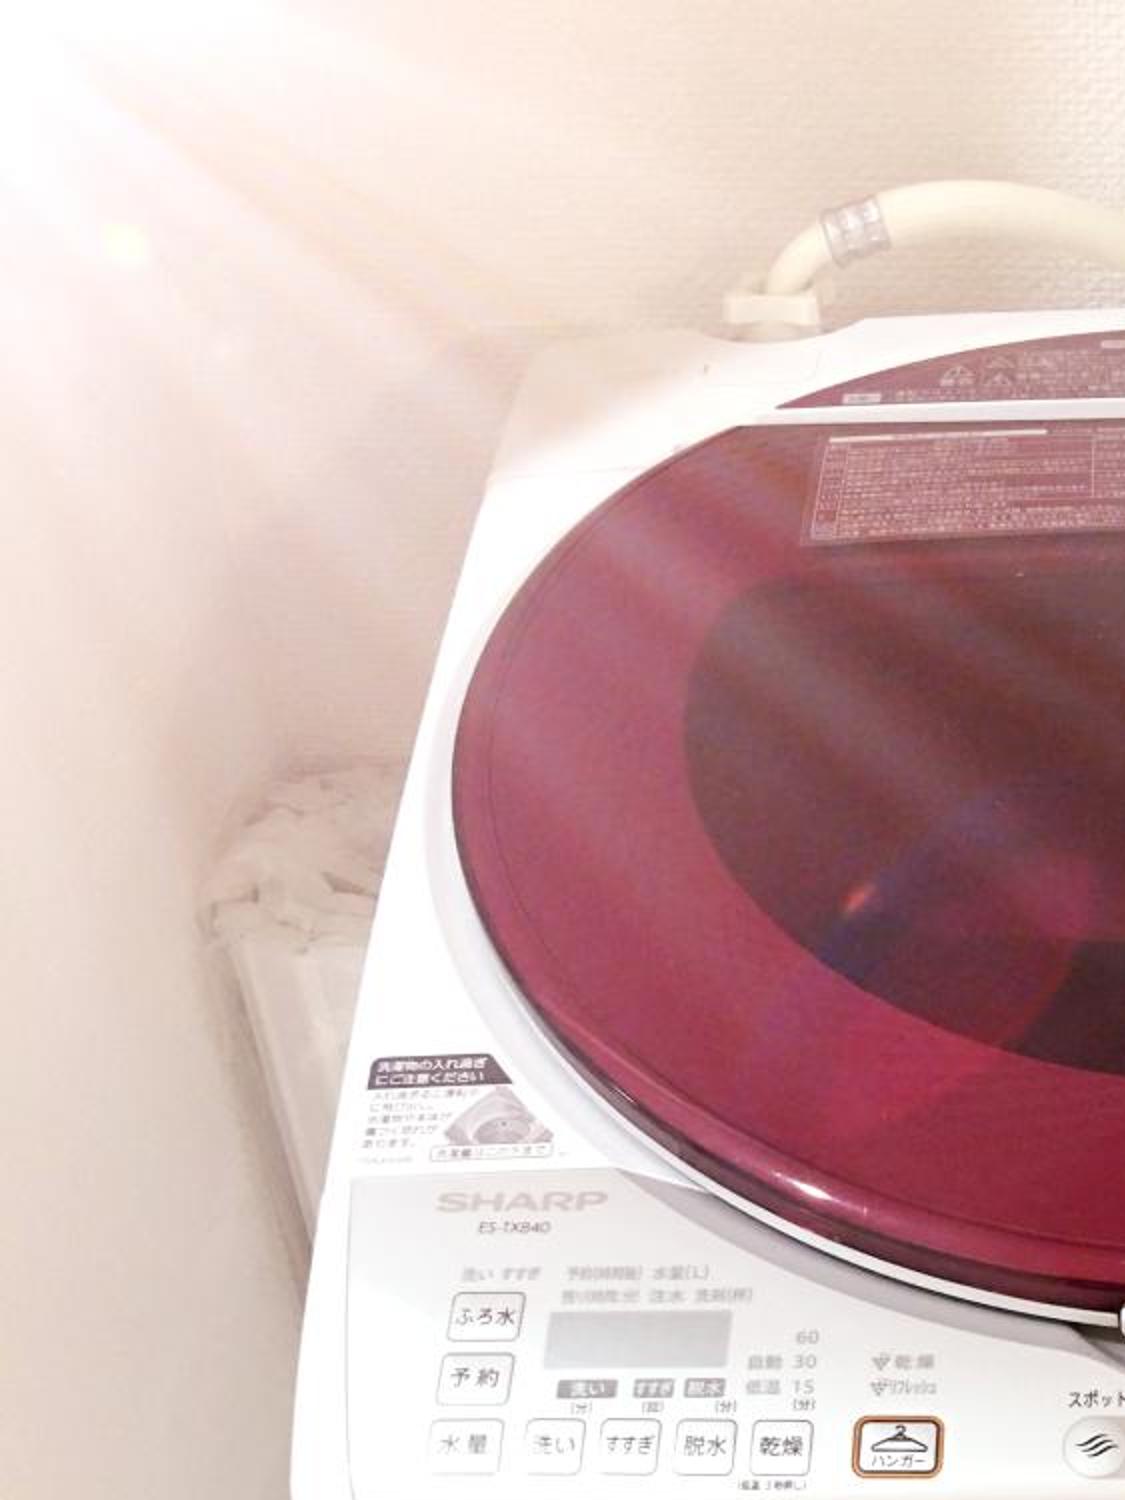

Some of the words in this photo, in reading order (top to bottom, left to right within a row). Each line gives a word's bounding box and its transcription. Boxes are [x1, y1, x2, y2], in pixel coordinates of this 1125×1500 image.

[376, 1056, 489, 1073] 洗濯物の入れ過ぎ
[374, 1072, 486, 1086] にご注意ください
[436, 1192, 608, 1212] SHARP
[455, 1307, 517, 1326] ふろ水
[796, 1330, 820, 1345] 60
[748, 1354, 783, 1369] 自動
[792, 1354, 817, 1369] 30
[894, 1353, 936, 1369] 乾燥
[450, 1366, 500, 1389] 予約
[687, 1381, 722, 1397] 脱水
[746, 1380, 781, 1395] 低温
[793, 1379, 815, 1395] 15
[440, 1434, 488, 1456] 水量
[531, 1435, 576, 1456] 洗い
[605, 1435, 654, 1456] すすぎ
[683, 1436, 727, 1457] 脱水
[758, 1436, 804, 1458] 乾燥
[871, 1454, 925, 1469] ハンガー
